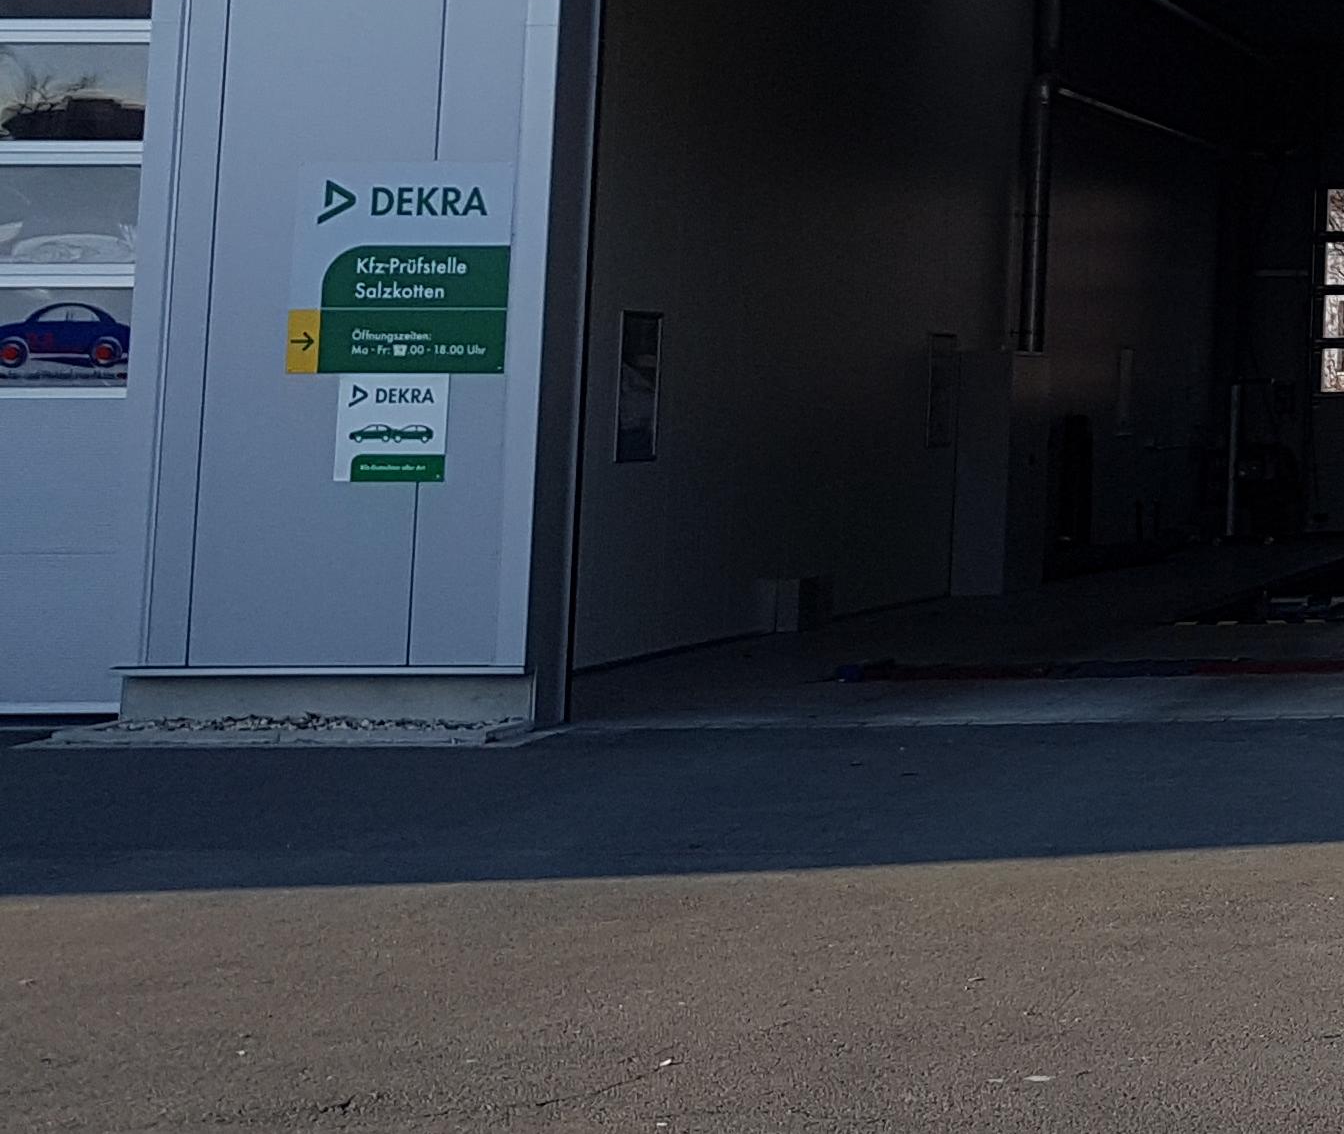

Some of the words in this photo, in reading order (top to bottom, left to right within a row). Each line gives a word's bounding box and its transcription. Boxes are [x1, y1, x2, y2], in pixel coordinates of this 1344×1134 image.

[371, 187, 487, 216] DEKRA
[356, 256, 467, 274] Kfz-Prüfstelle
[355, 281, 445, 298] Salzkotten
[351, 328, 432, 343] Öffnungszeiten:
[434, 345, 464, 355] 18.00
[467, 344, 486, 355] Uhr
[375, 388, 434, 403] DEKRA
